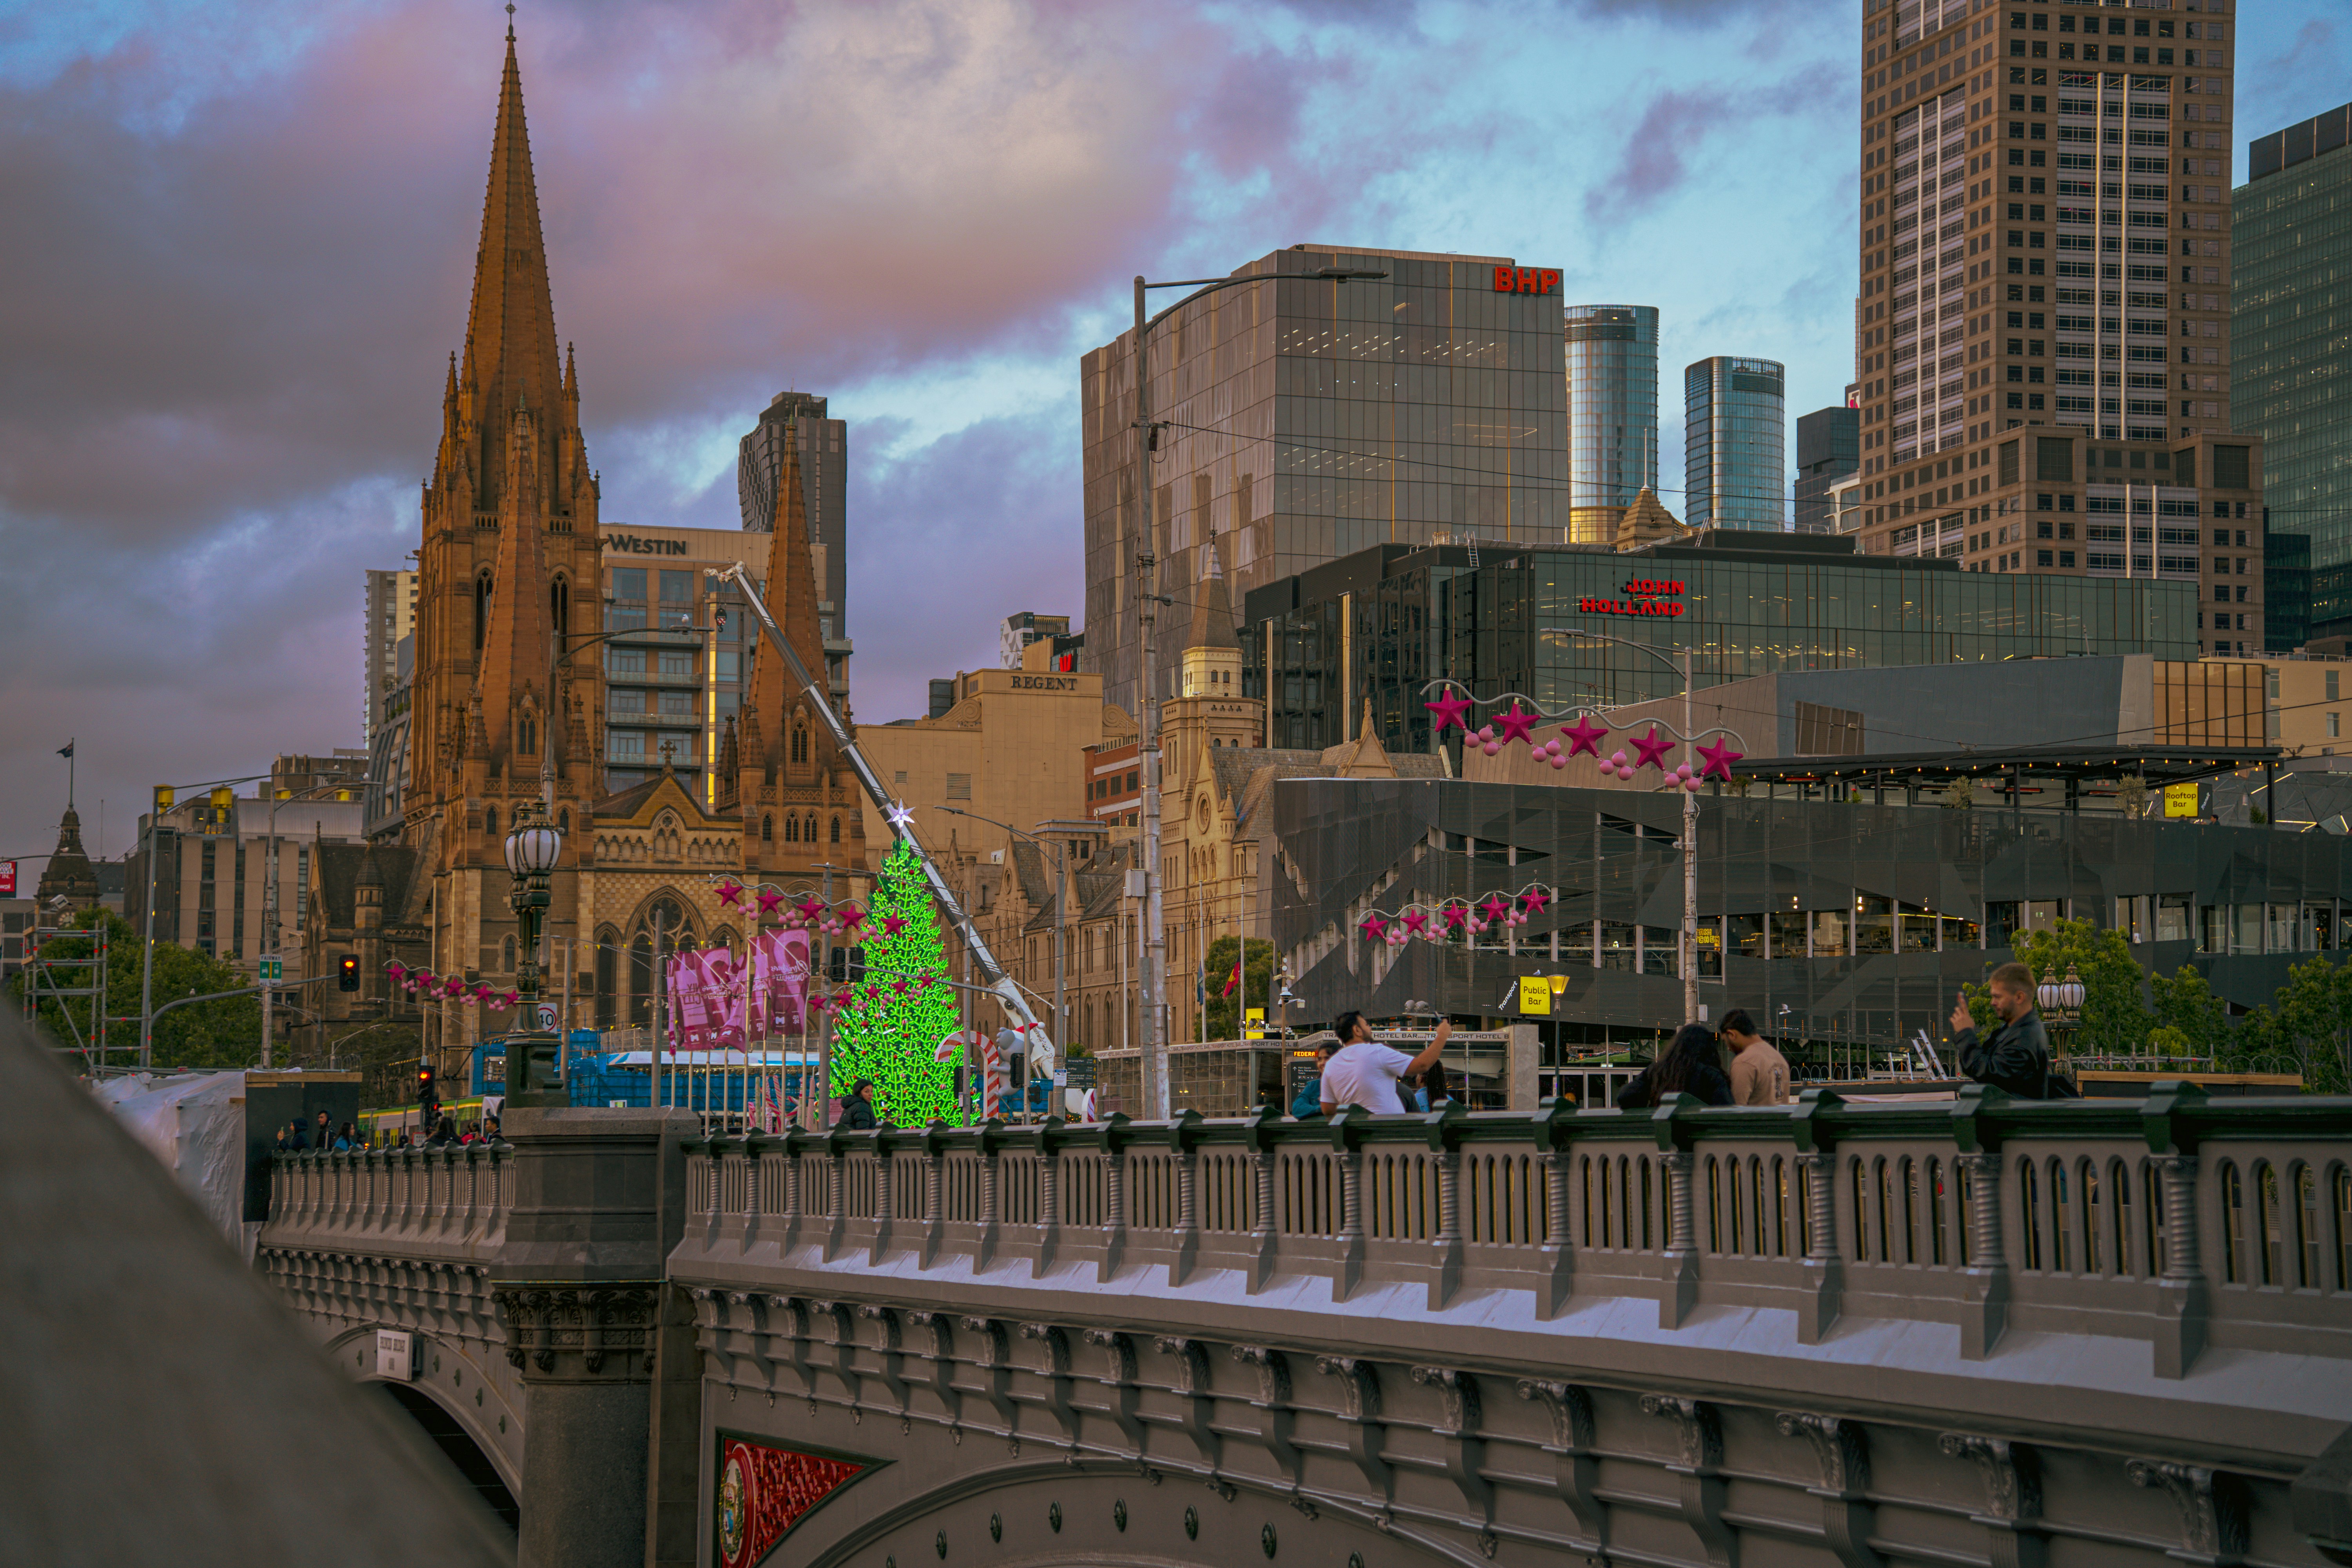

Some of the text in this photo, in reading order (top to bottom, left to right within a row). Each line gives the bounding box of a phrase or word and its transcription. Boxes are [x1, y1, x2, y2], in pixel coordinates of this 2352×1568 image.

[1495, 267, 1559, 294] BHP
[1627, 579, 1684, 594] JOHN
[1582, 598, 1684, 615] HOLLAND
[1011, 676, 1077, 690] REGENT
[1498, 981, 1518, 1011] Transport
